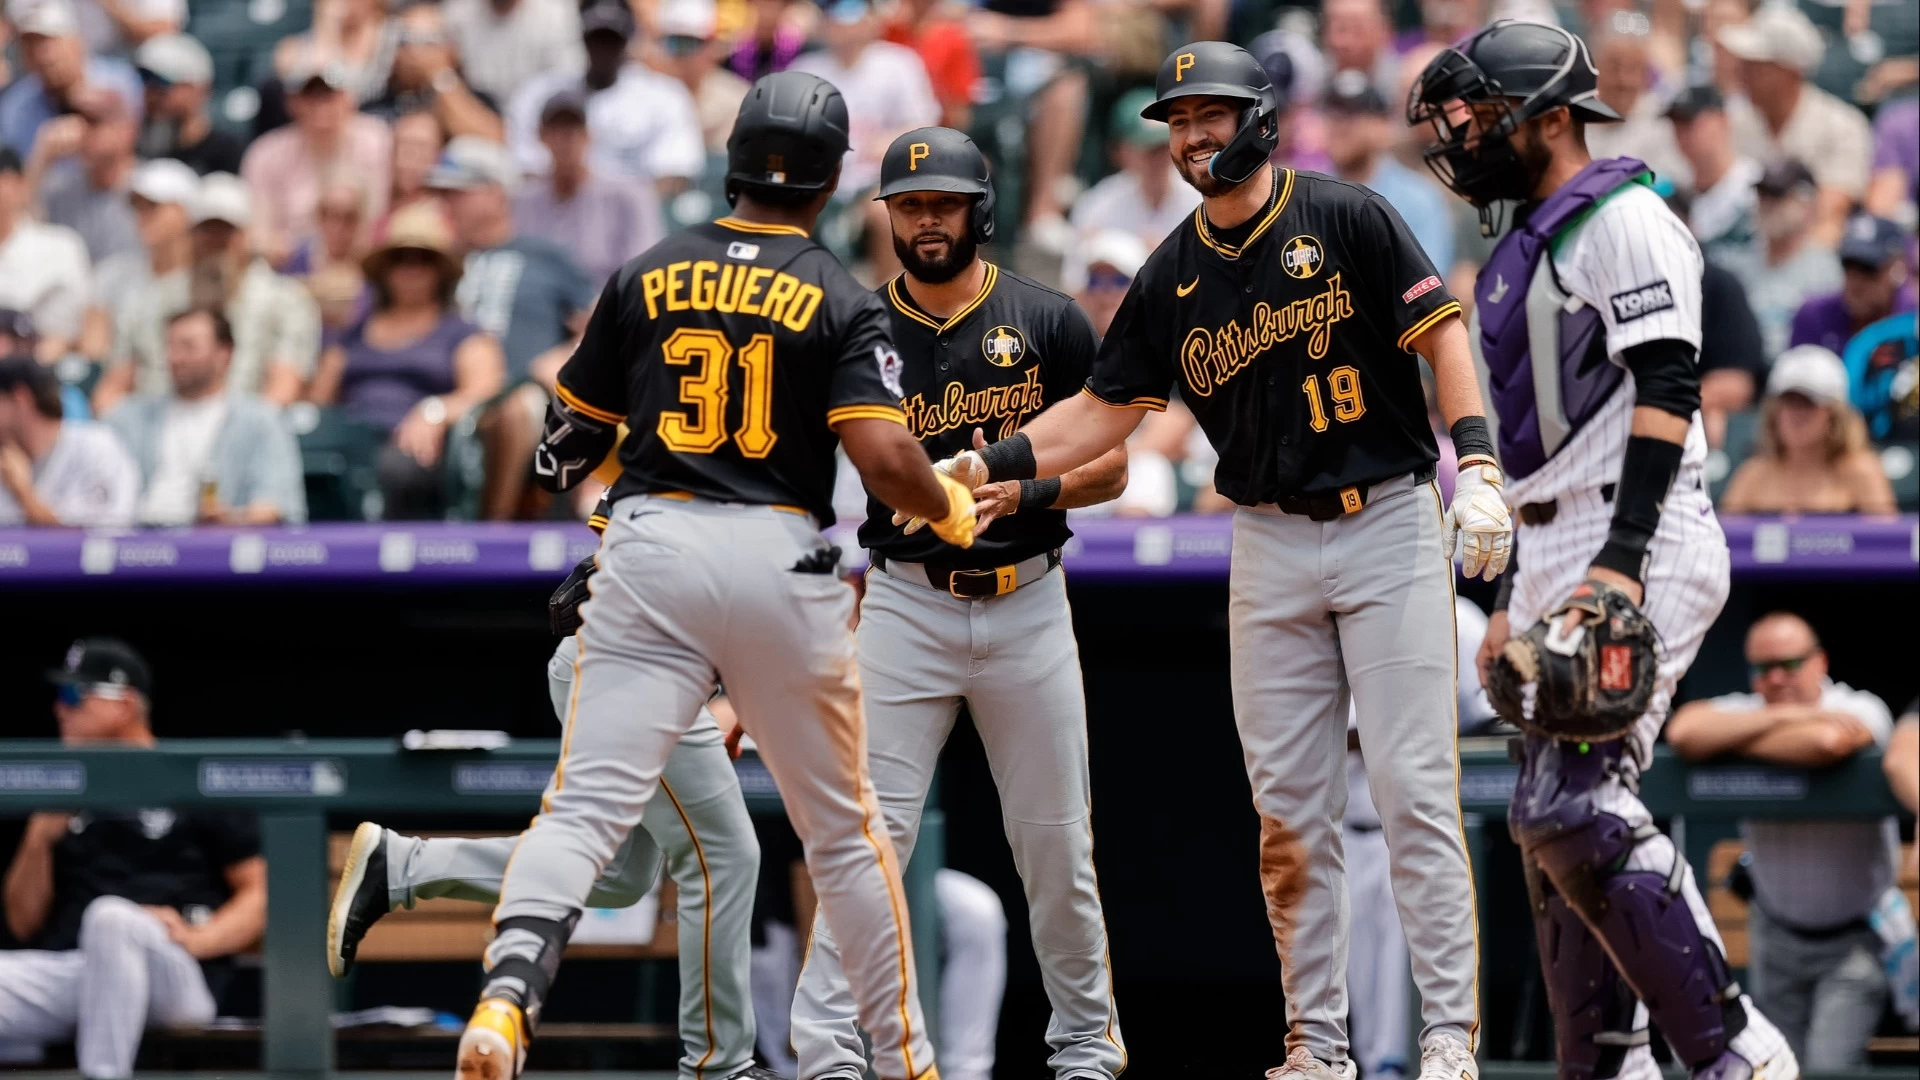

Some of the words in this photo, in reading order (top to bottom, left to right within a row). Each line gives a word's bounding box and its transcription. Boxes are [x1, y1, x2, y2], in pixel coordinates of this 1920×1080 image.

[1176, 52, 1195, 82] P
[910, 142, 930, 171] P
[1285, 245, 1321, 268] COBRA
[641, 260, 824, 332] PEGUERO
[1611, 284, 1672, 315] YORK
[986, 336, 1022, 354] COBRA
[1181, 271, 1354, 397] Pittsburgh
[656, 327, 778, 459] 31
[900, 363, 1044, 442] ttsburgh
[1302, 365, 1367, 433] 19
[1345, 493, 1357, 508] 19
[1003, 574, 1011, 590] 7
